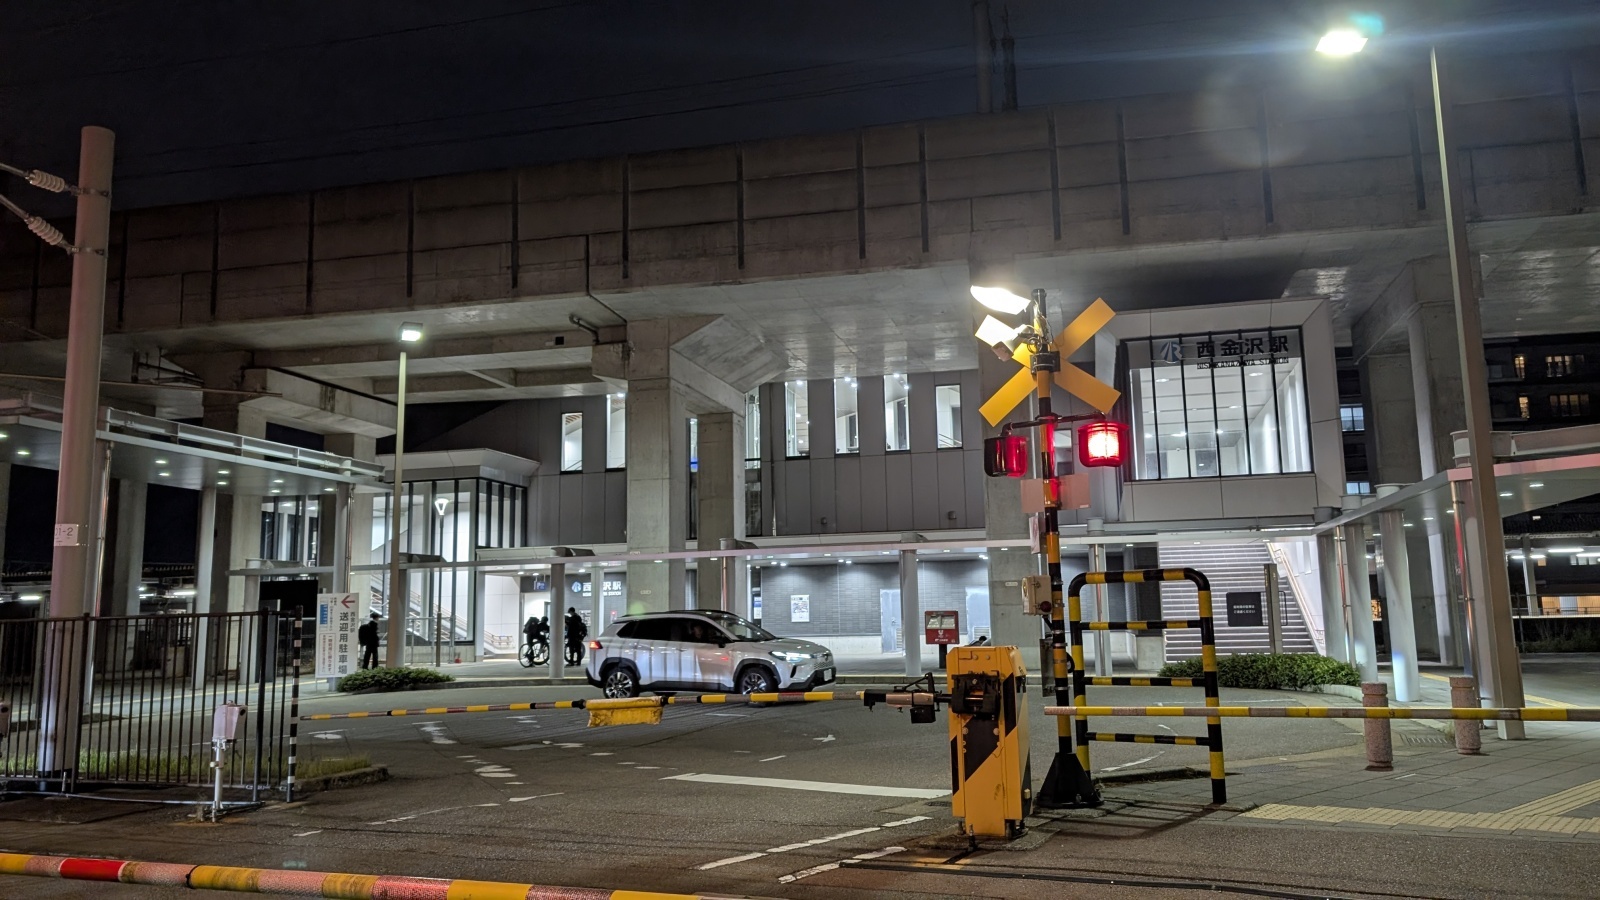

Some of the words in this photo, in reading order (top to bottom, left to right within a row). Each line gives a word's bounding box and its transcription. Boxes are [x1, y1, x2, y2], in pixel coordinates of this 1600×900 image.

[1196, 335, 1289, 358] 西金沢駅
[582, 581, 622, 591] 西沢駅
[338, 611, 349, 675] 送迎用駐車場
